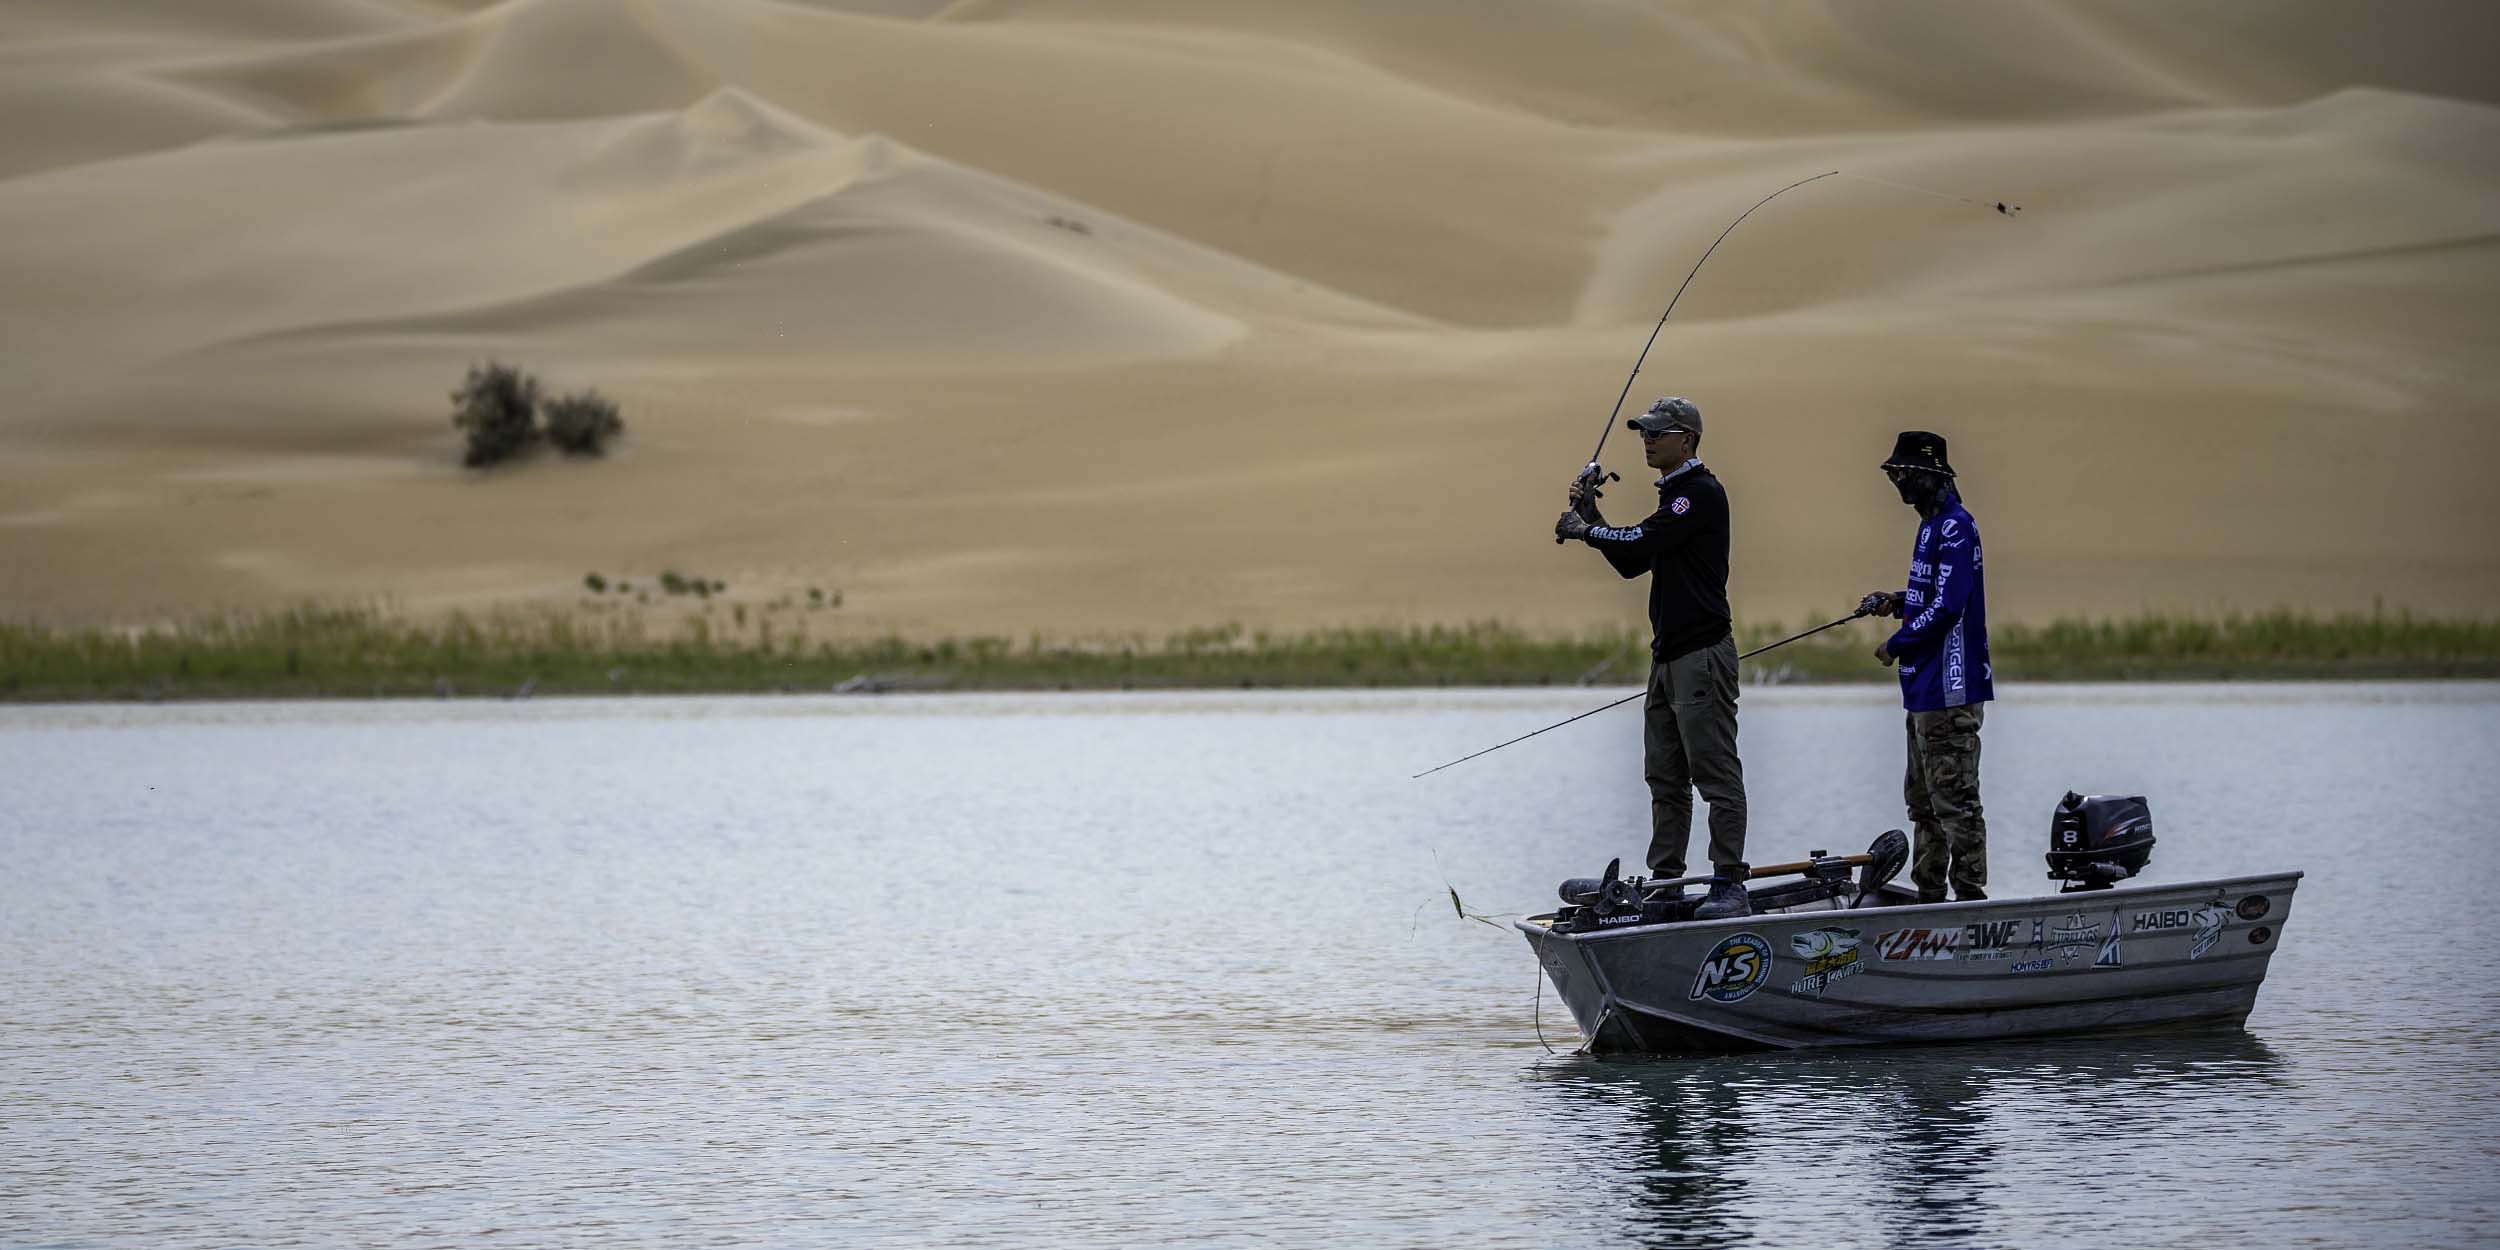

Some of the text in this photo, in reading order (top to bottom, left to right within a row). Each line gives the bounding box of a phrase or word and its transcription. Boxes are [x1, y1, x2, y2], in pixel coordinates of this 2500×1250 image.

[2063, 830, 2077, 843] 8
[1599, 914, 1640, 925] HAIBO
[2133, 910, 2190, 931] HAIBO
